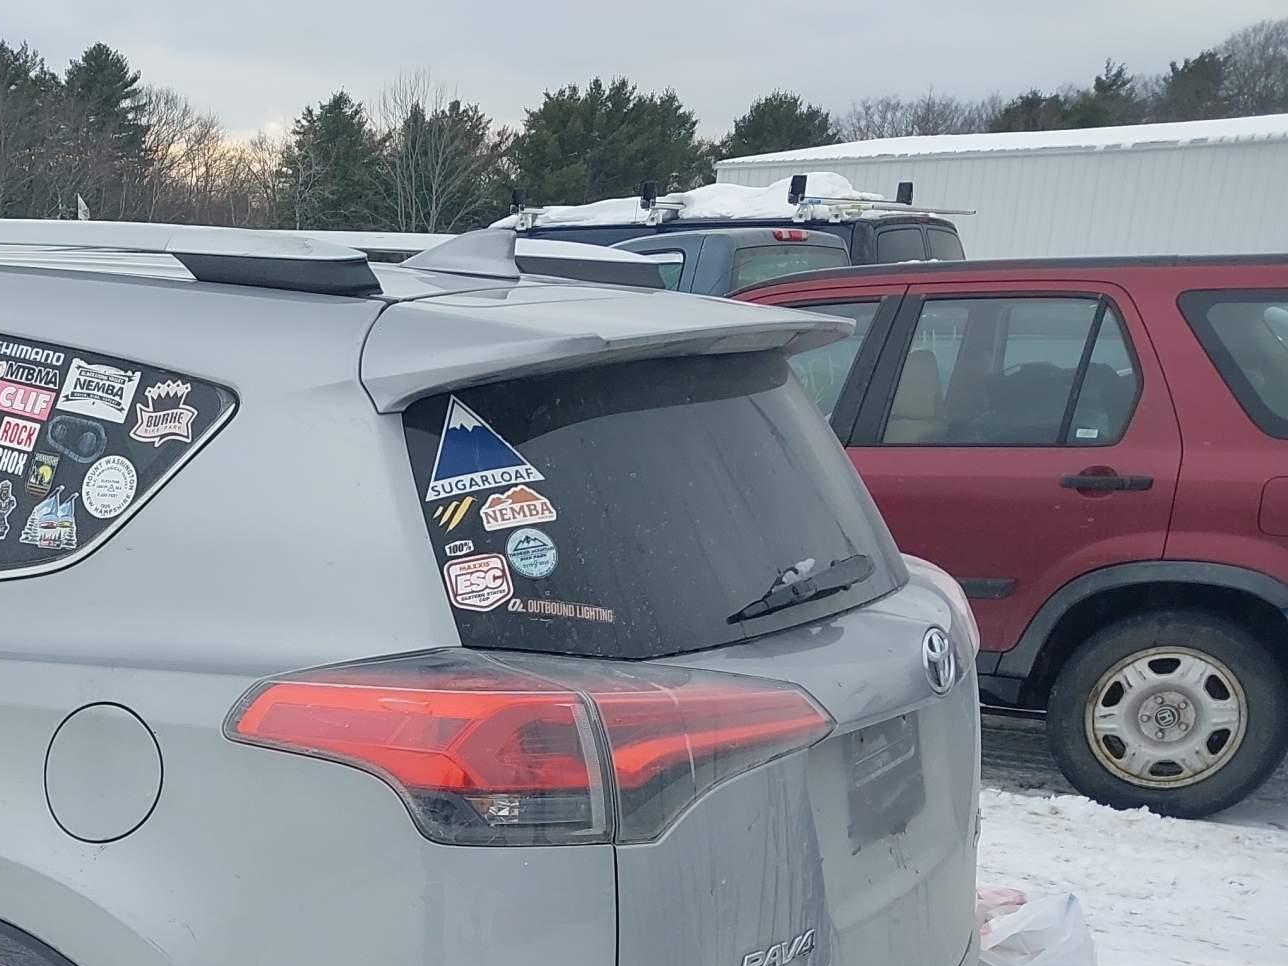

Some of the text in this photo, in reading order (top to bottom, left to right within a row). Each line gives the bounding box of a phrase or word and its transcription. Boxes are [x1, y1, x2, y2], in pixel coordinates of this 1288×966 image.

[4, 362, 59, 388] MTBMA
[0, 386, 51, 415] CLIF
[73, 377, 125, 401] NEMBA
[146, 411, 185, 428] BURKE
[0, 421, 37, 448] ROCK
[85, 457, 135, 491] MOUNT WASHINGTON
[431, 468, 534, 497] SUGARLOAF
[85, 490, 132, 514] NEW HAMPSHIRE
[482, 501, 553, 525] NEMBA
[447, 541, 472, 555] 100%
[459, 561, 490, 571] MAXXIS
[456, 567, 504, 595] ESC
[527, 599, 575, 617] OUTBOUND
[576, 605, 614, 623] LIGHTING
